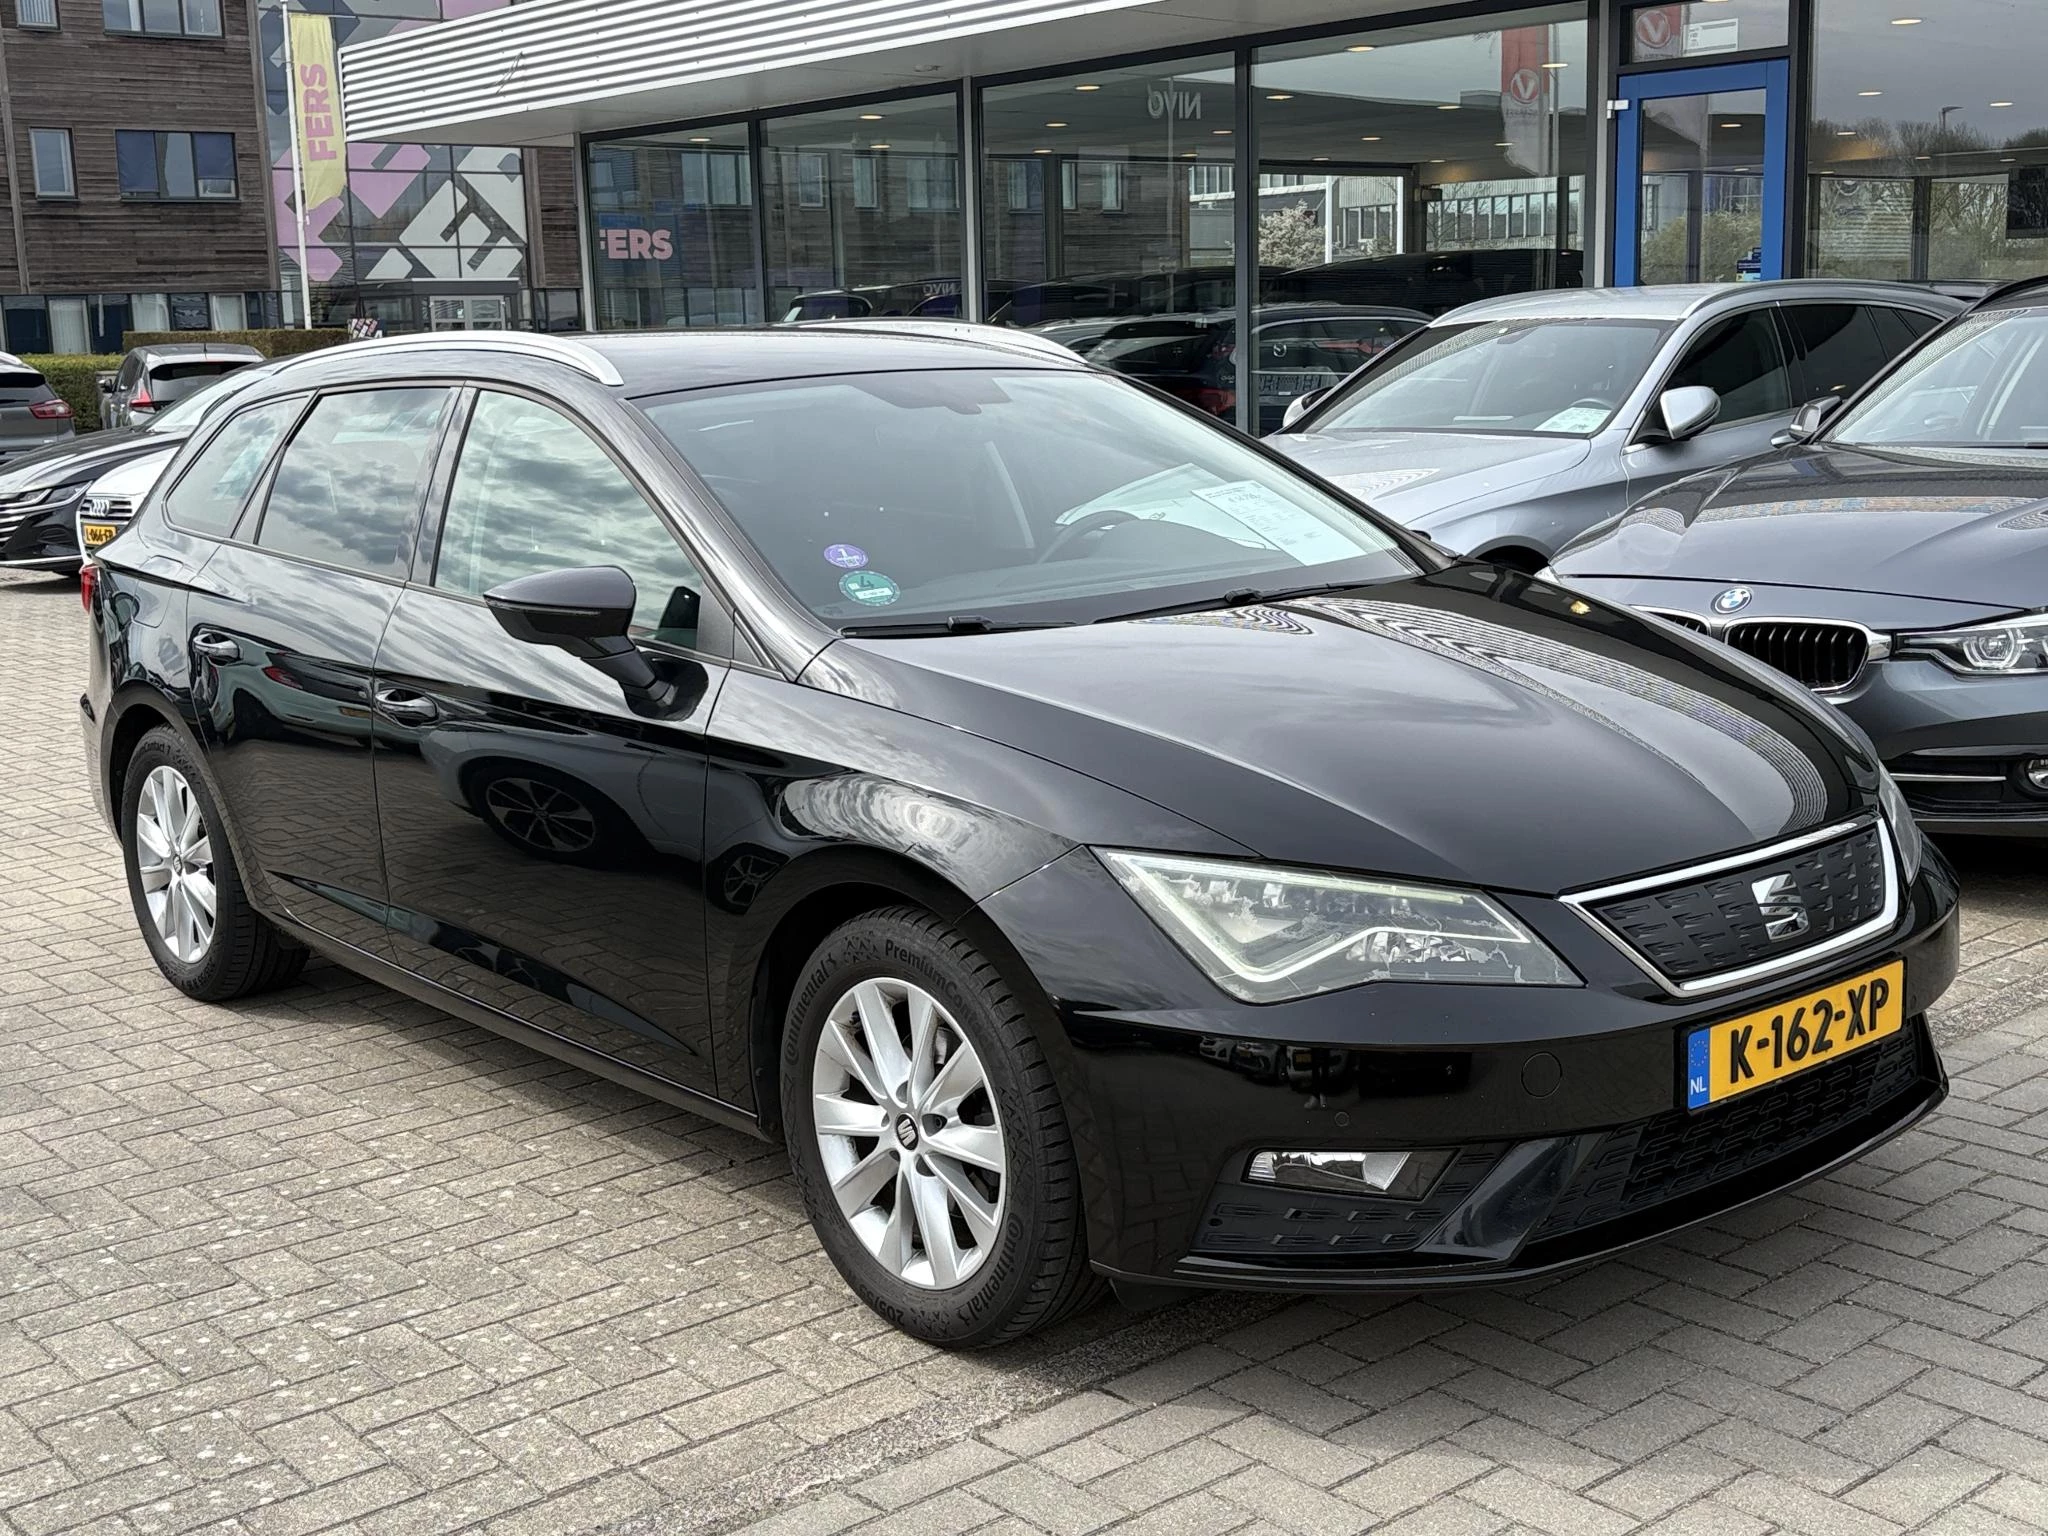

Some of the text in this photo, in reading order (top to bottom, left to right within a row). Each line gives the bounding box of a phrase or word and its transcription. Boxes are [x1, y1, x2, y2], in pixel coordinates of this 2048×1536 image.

[301, 63, 337, 161] FERS
[784, 959, 834, 1066] Continental
[1730, 977, 1889, 1084] K-162-XP
[1689, 1075, 1707, 1096] NL
[968, 1212, 1025, 1326] Continental
